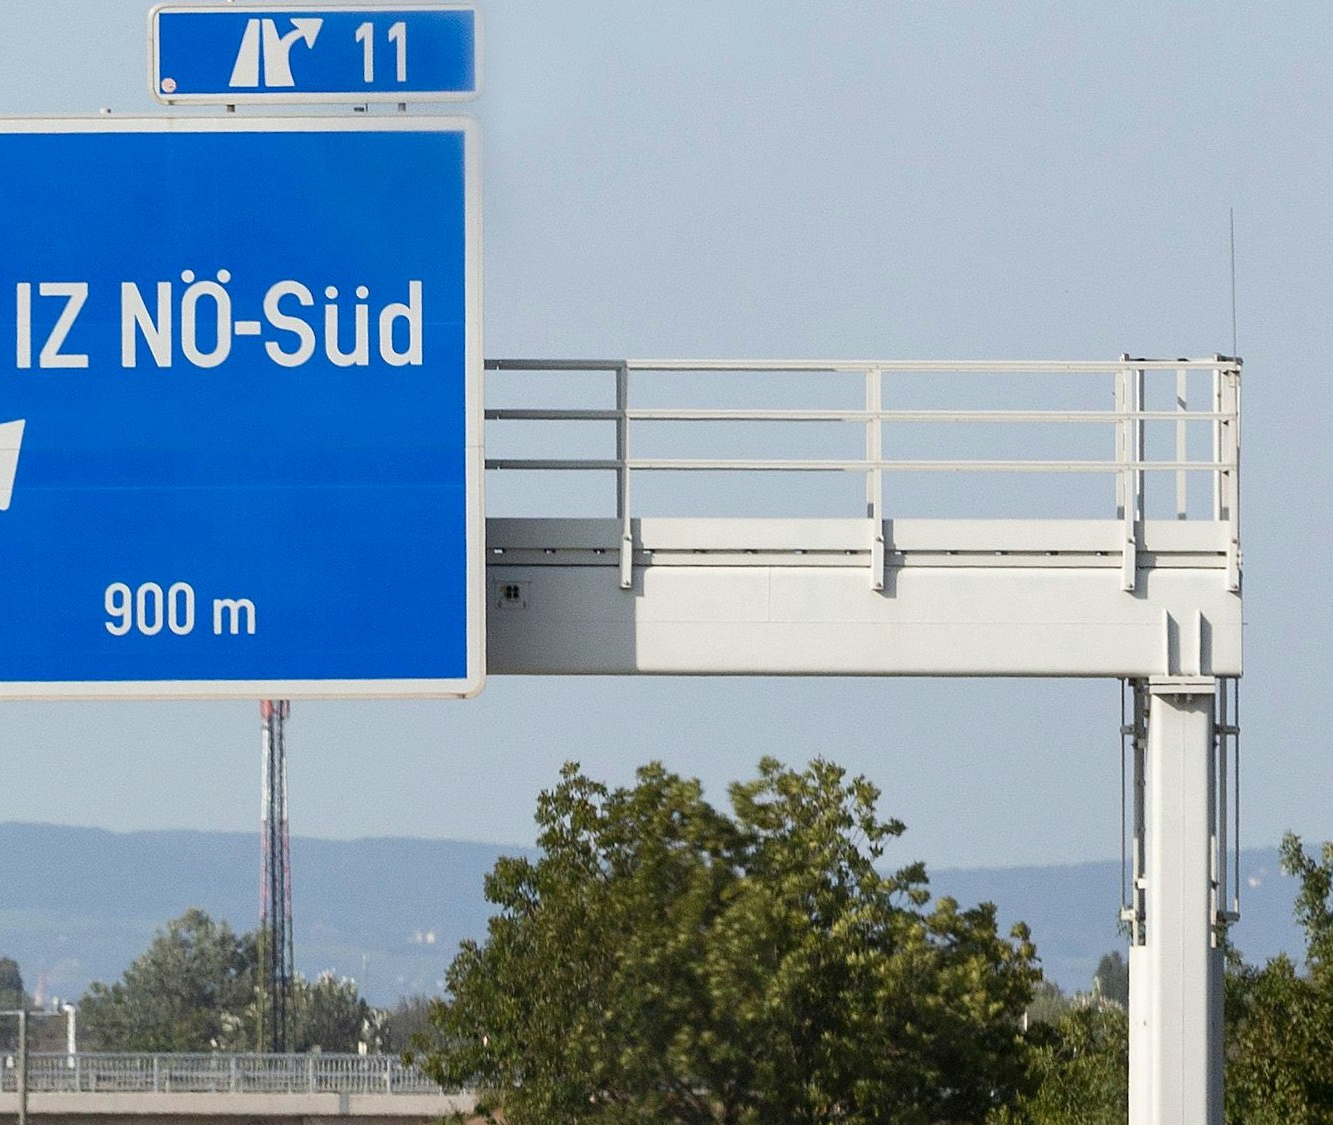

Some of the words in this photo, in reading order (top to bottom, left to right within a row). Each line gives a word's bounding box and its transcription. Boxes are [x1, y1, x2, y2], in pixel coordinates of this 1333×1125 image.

[355, 21, 407, 83] 11
[16, 282, 89, 369] IZ
[121, 269, 423, 368] NÖ-Süd
[104, 581, 195, 636] 900
[213, 598, 256, 635] m
